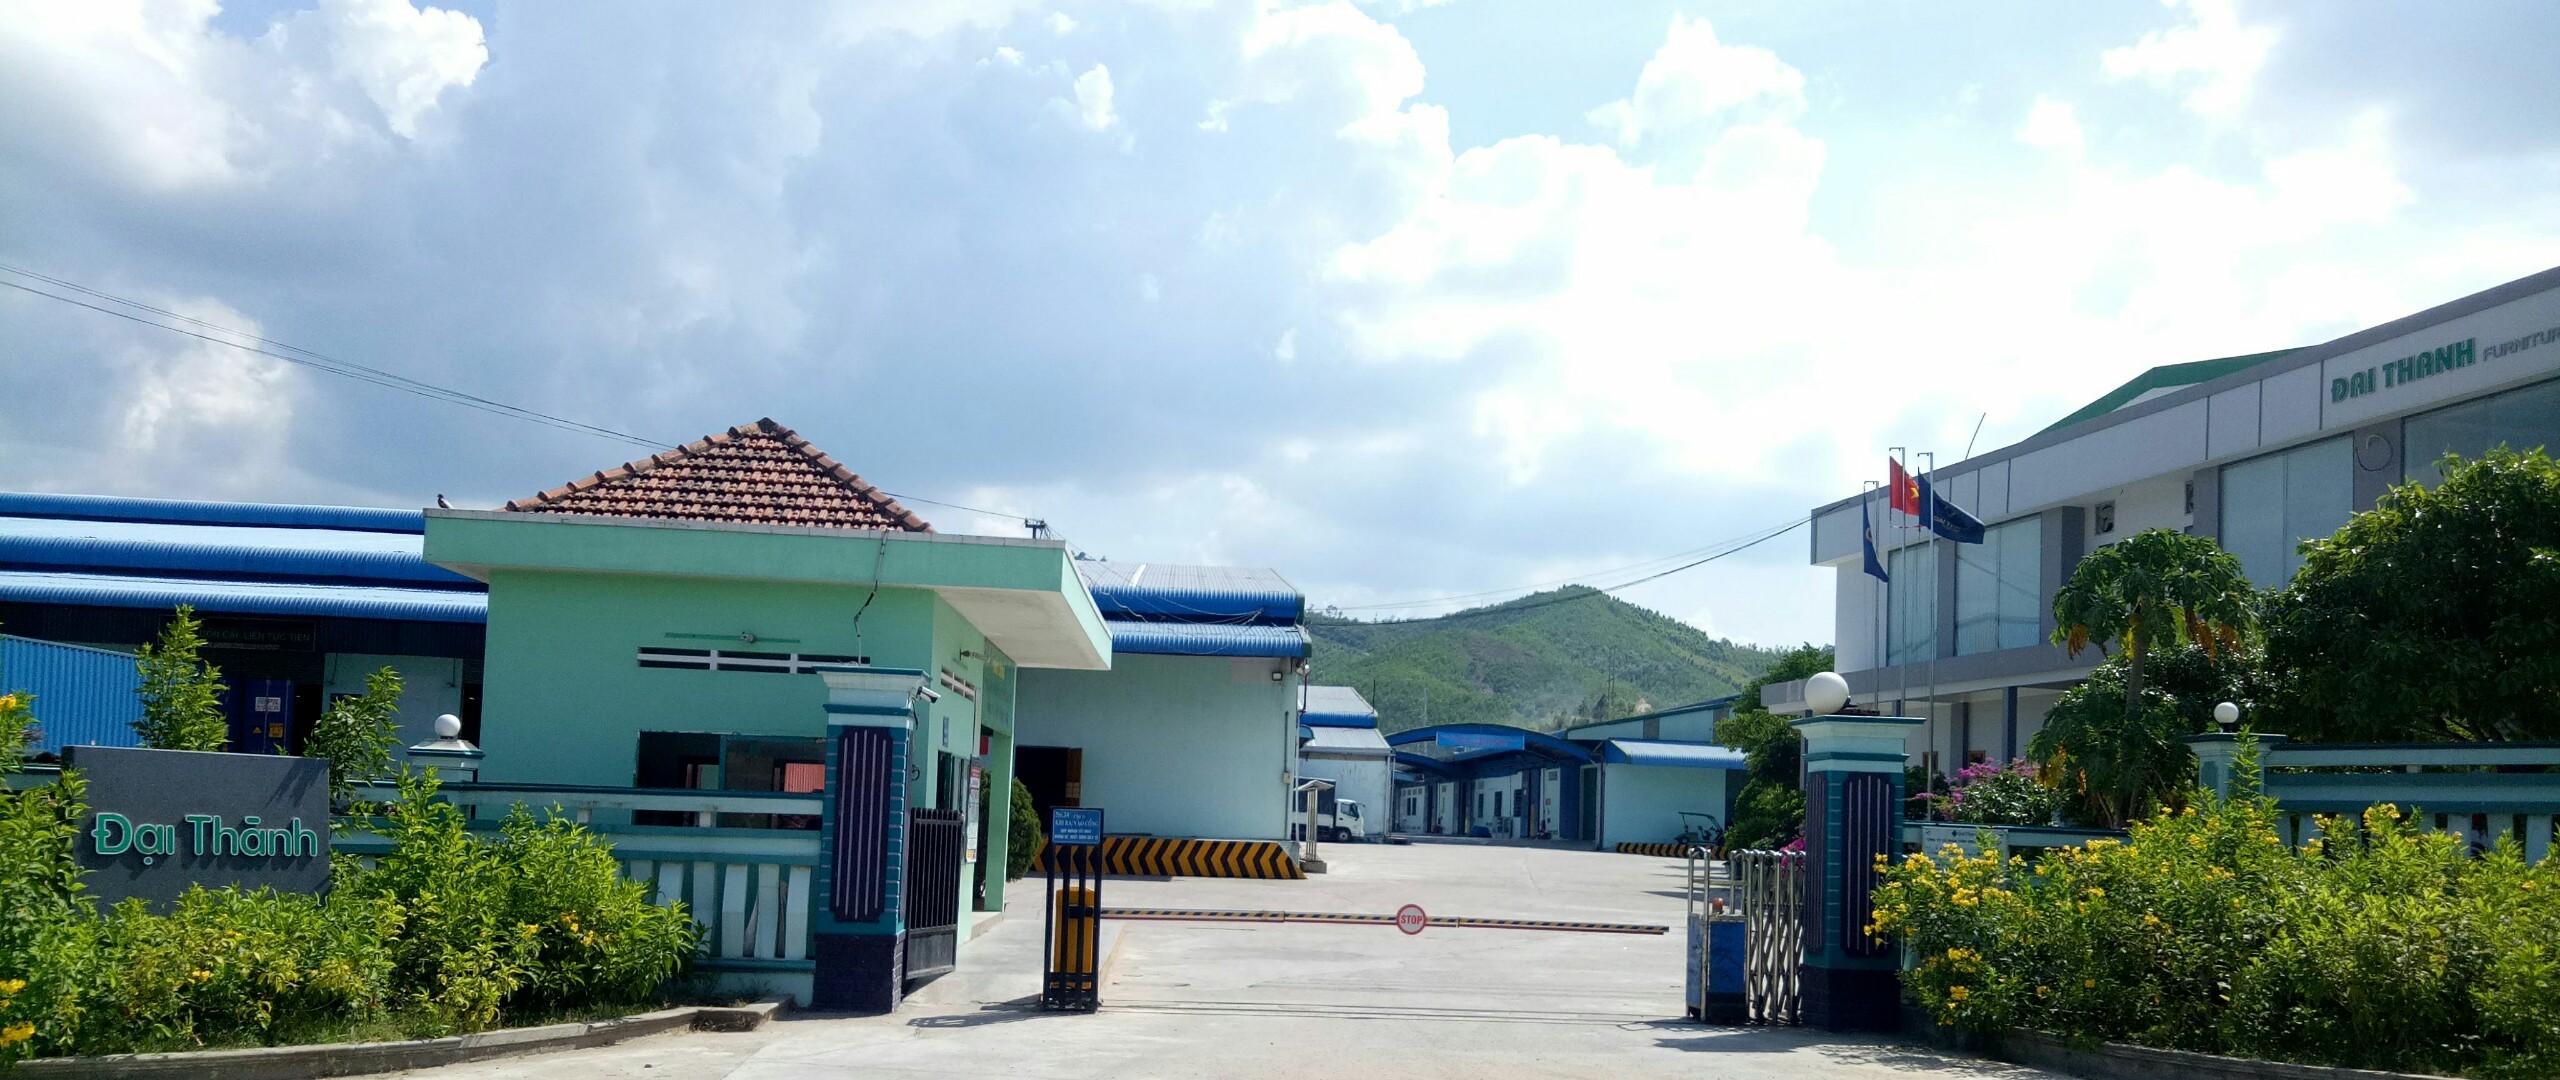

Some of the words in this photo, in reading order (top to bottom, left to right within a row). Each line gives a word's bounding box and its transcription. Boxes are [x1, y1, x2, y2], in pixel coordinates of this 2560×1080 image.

[2382, 337, 2476, 387] THANH
[91, 812, 175, 866] Đại
[1400, 914, 1423, 925] STOP
